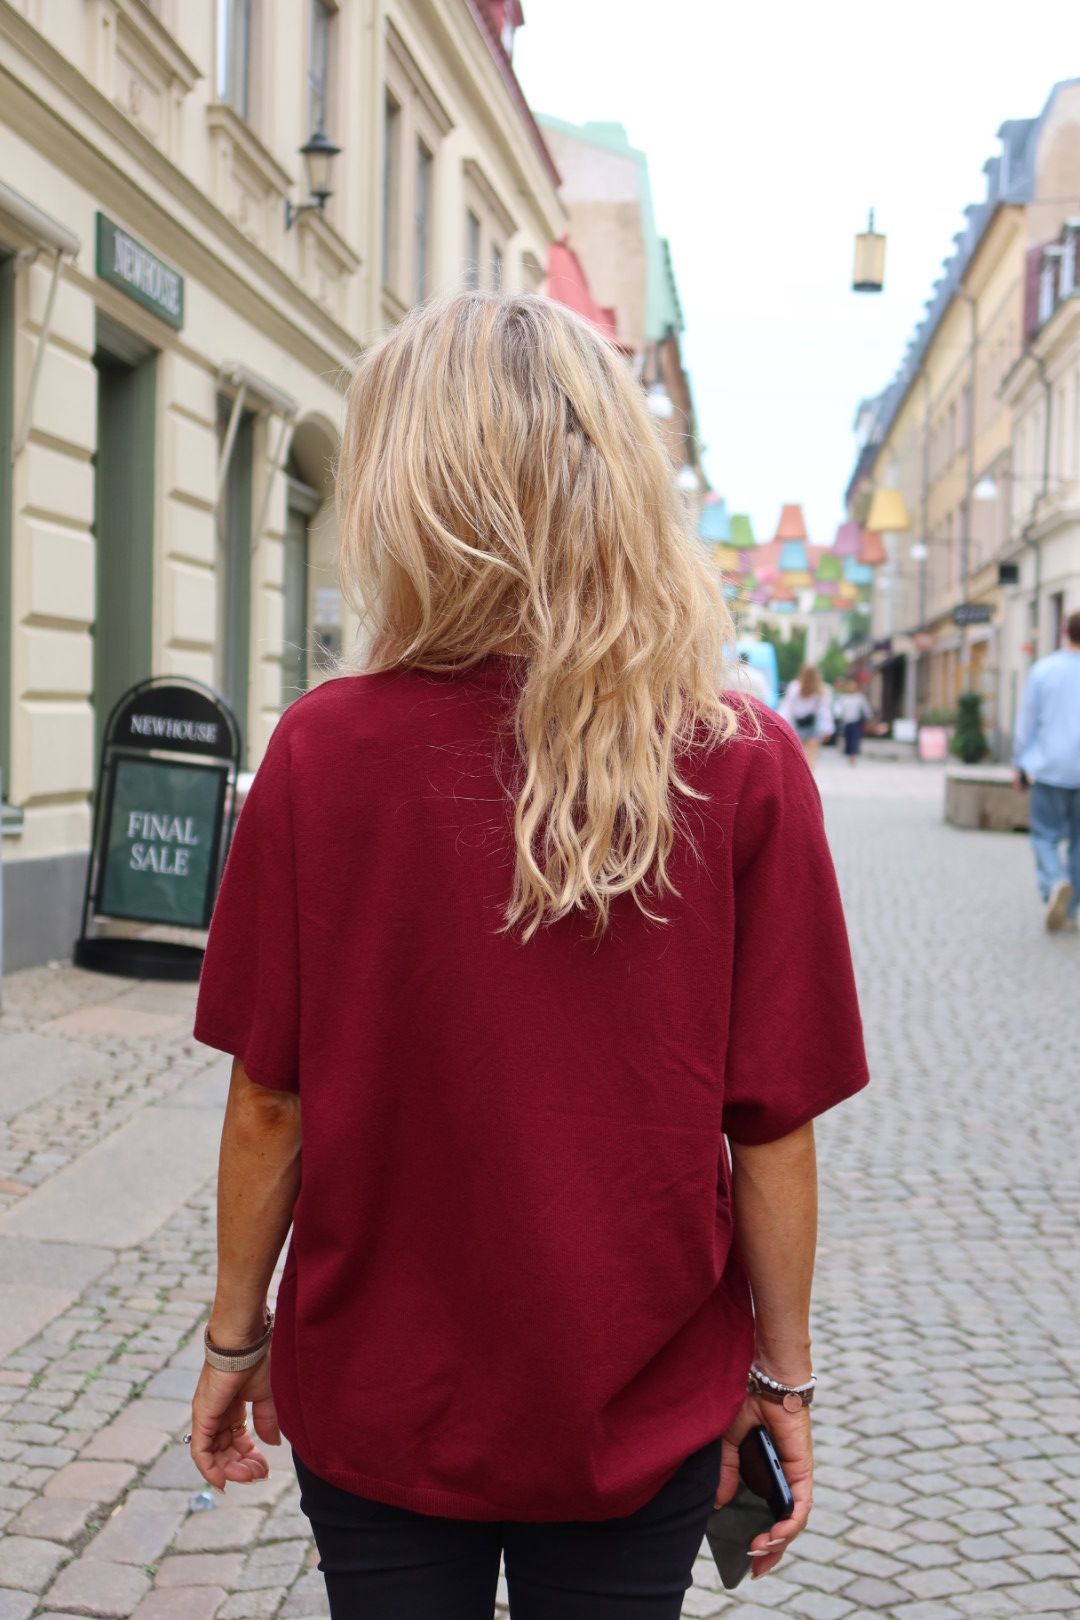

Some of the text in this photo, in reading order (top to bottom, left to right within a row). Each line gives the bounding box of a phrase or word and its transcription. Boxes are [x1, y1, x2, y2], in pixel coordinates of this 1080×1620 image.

[113, 229, 180, 315] NEWHOUSE
[131, 714, 217, 743] NEWHOUSE
[127, 811, 199, 846] FINAL
[129, 842, 190, 876] SALE
